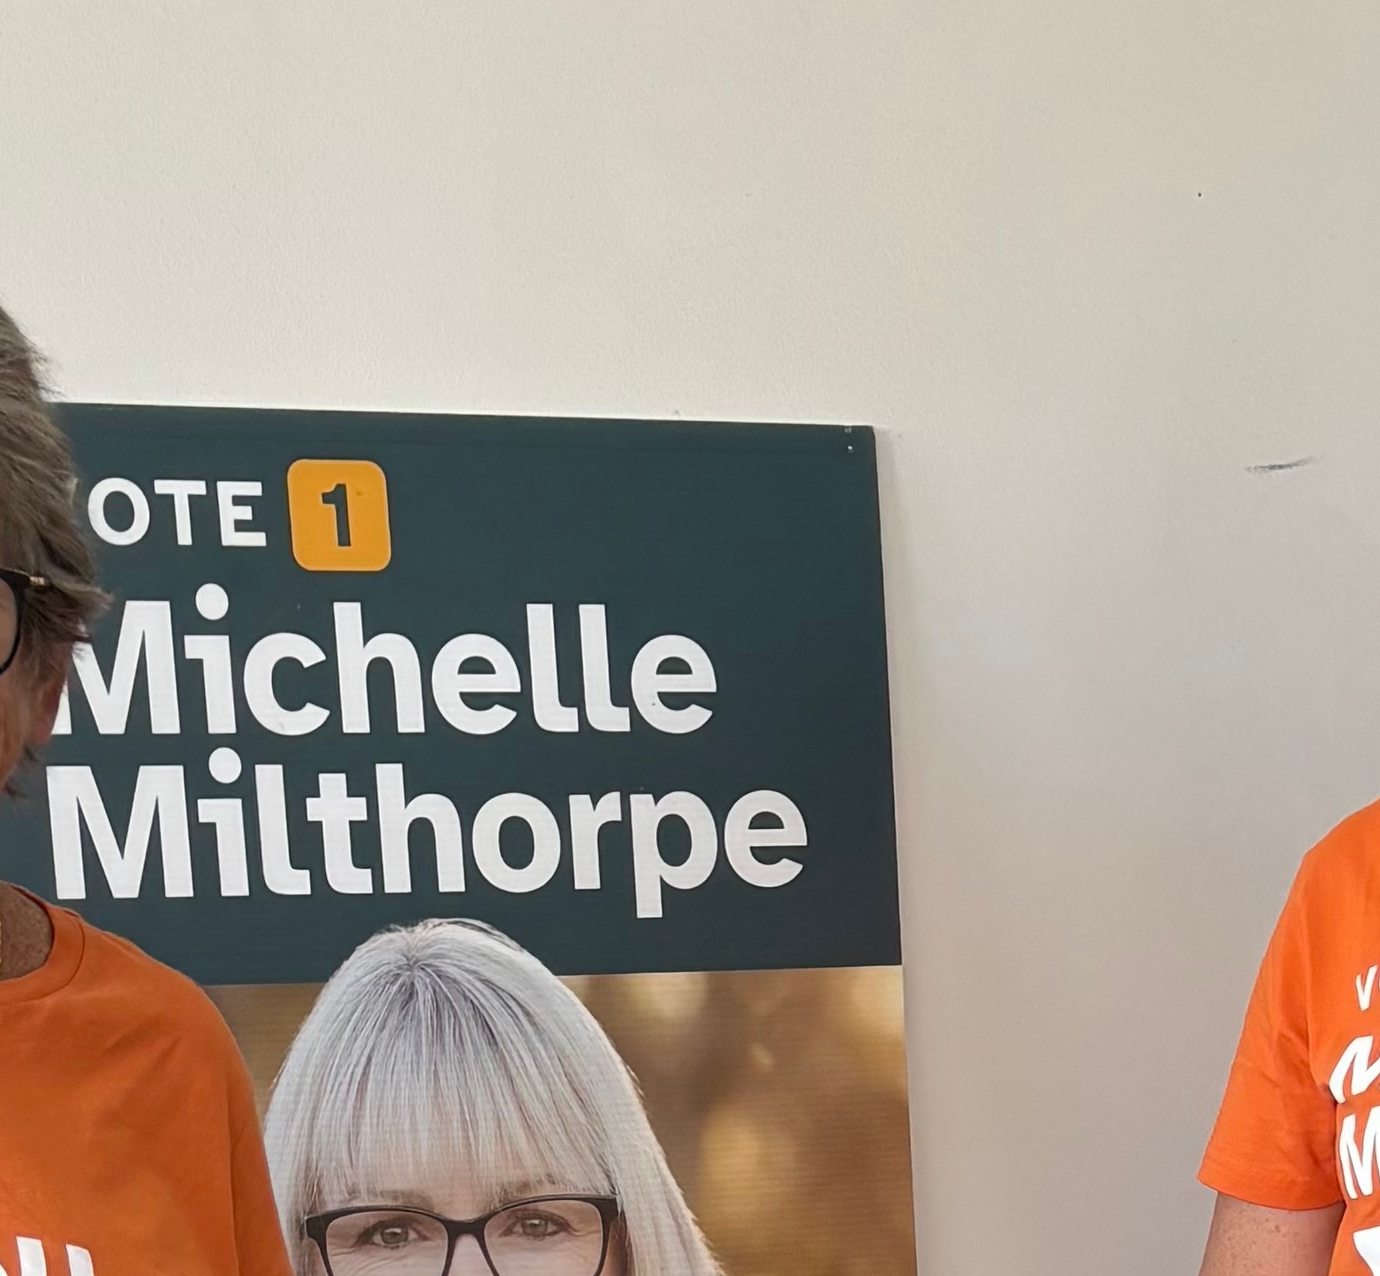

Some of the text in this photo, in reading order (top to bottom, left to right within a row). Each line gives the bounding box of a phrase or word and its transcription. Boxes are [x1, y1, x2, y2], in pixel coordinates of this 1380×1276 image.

[87, 477, 351, 547] OTE 1
[53, 582, 718, 736] Michelle
[46, 746, 809, 919] Milthorpe
